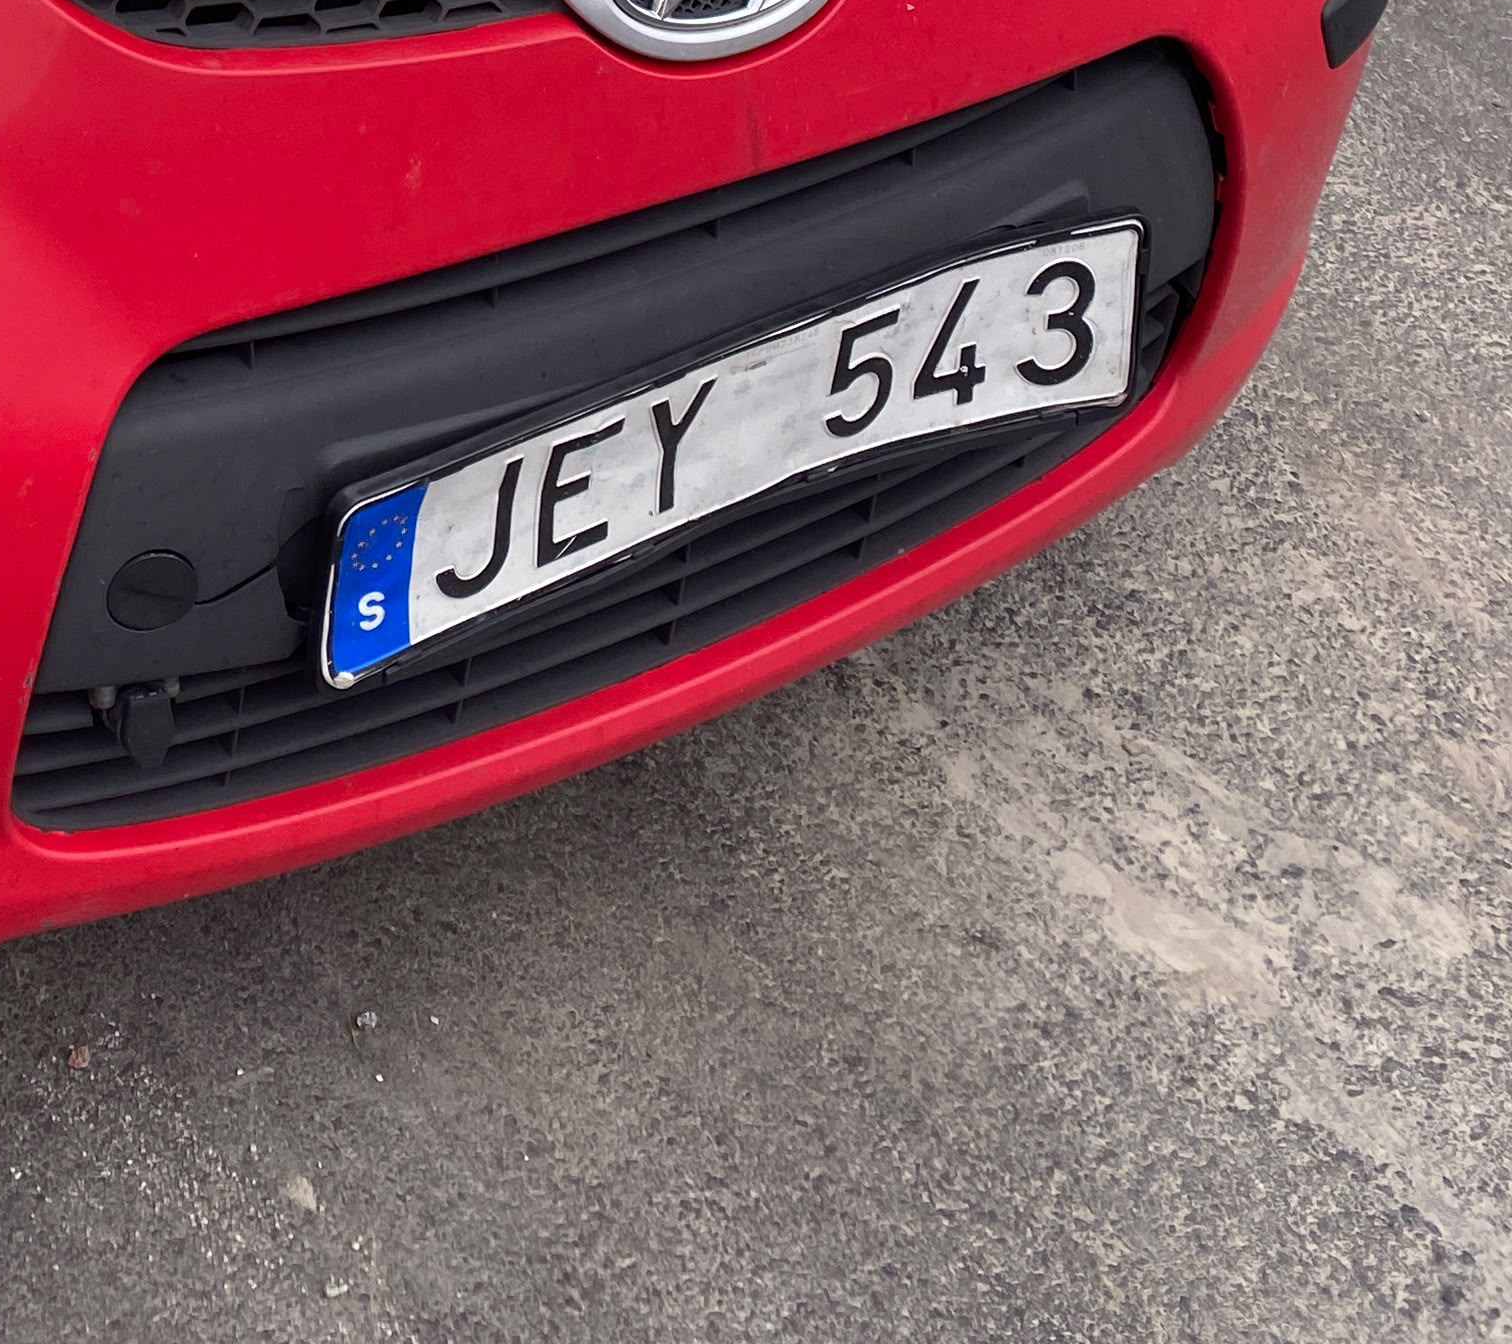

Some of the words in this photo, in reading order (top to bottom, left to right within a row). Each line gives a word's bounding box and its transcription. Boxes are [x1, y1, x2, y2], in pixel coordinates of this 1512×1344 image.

[435, 378, 717, 599] JEY
[824, 259, 1097, 438] 543
[357, 591, 386, 631] S
